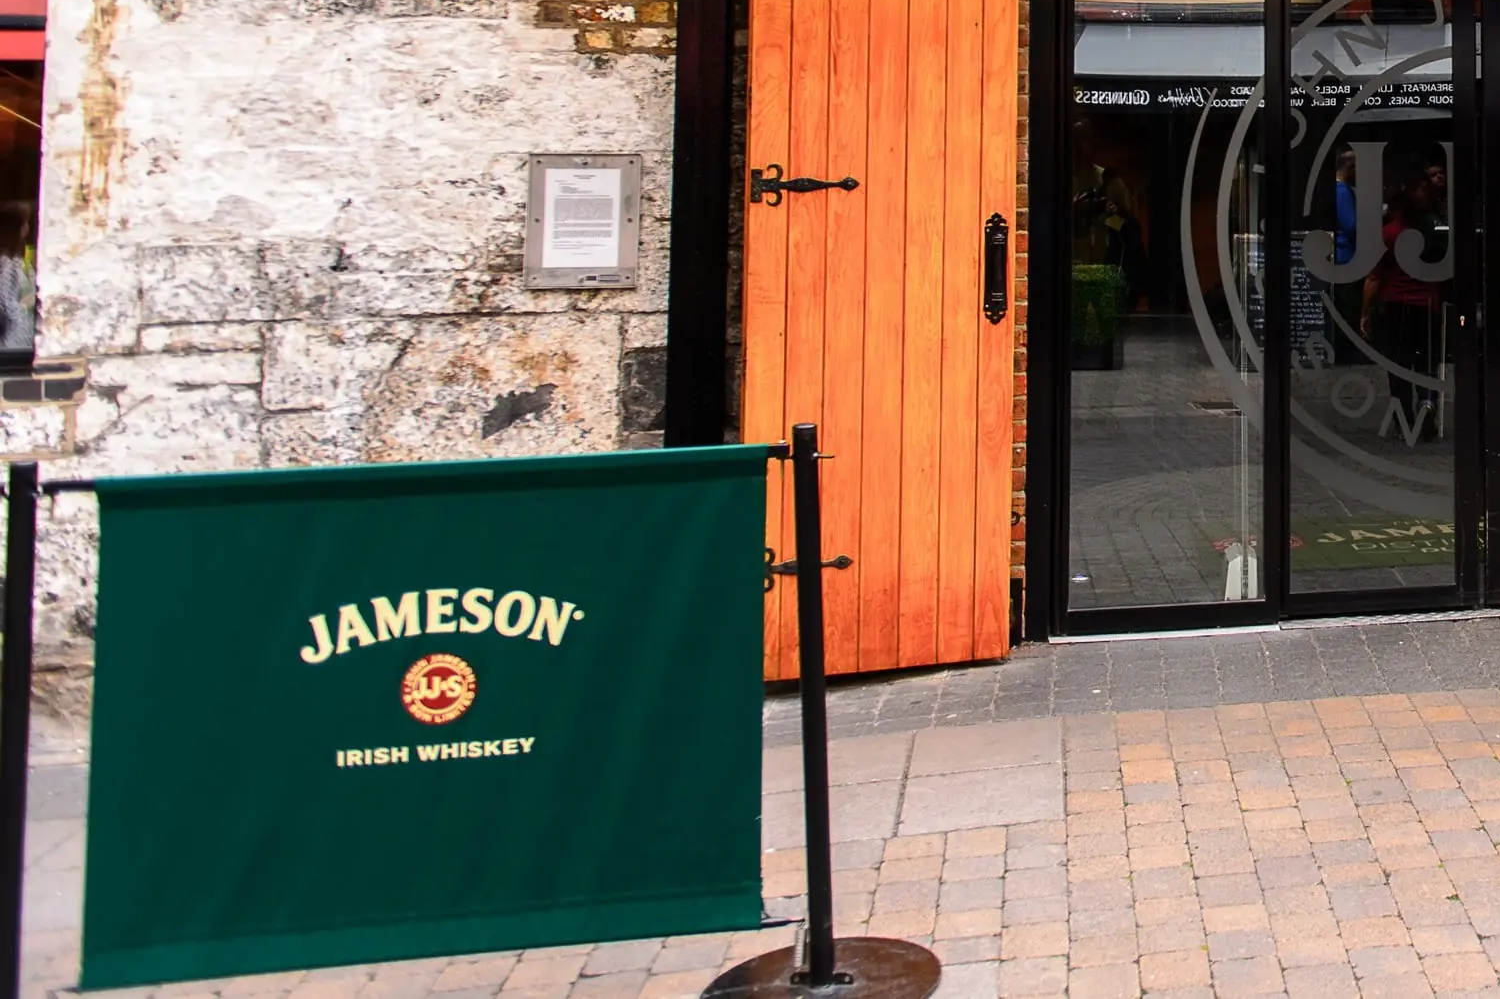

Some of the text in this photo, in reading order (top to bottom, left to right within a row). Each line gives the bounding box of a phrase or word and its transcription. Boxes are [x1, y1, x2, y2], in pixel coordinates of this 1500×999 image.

[300, 587, 576, 665] JAMESON
[336, 737, 536, 768] IRISH WHISKEY
